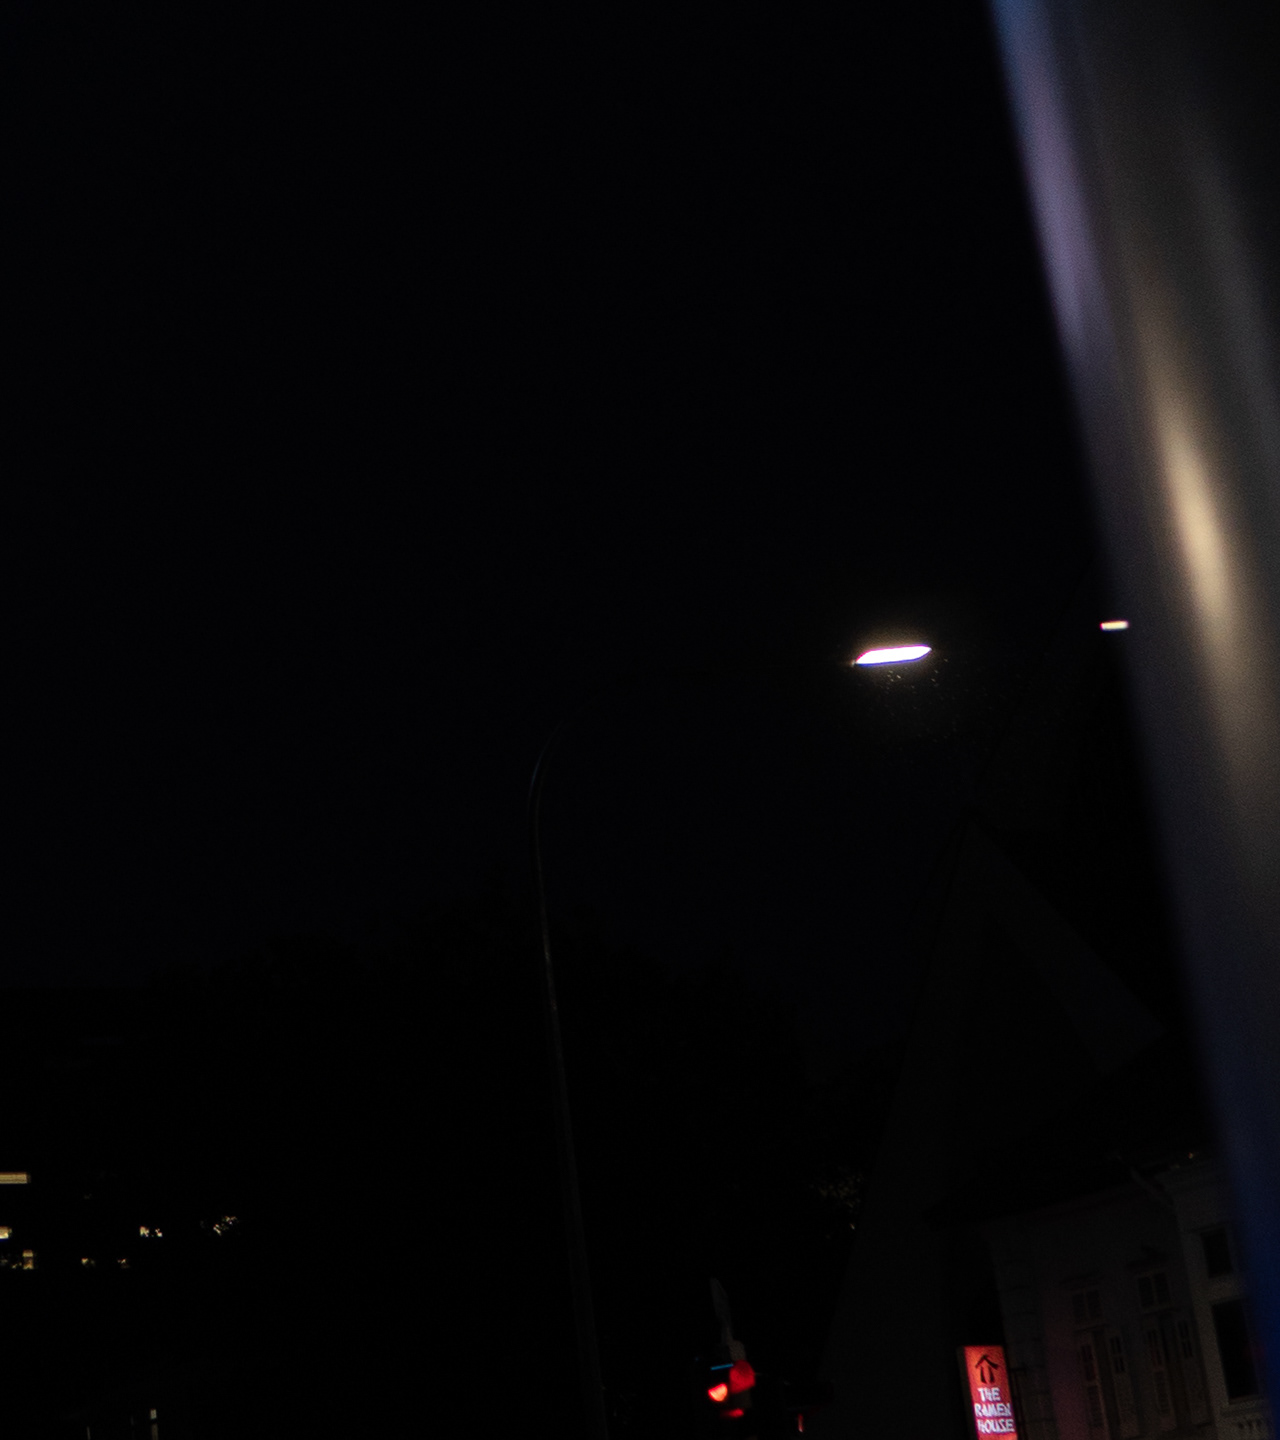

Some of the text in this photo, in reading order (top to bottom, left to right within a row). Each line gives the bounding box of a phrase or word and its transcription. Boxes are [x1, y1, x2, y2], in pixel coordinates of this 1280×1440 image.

[977, 1387, 1001, 1402] THE
[974, 1402, 1011, 1417] RAMEN
[977, 1418, 1015, 1434] HOUSE
